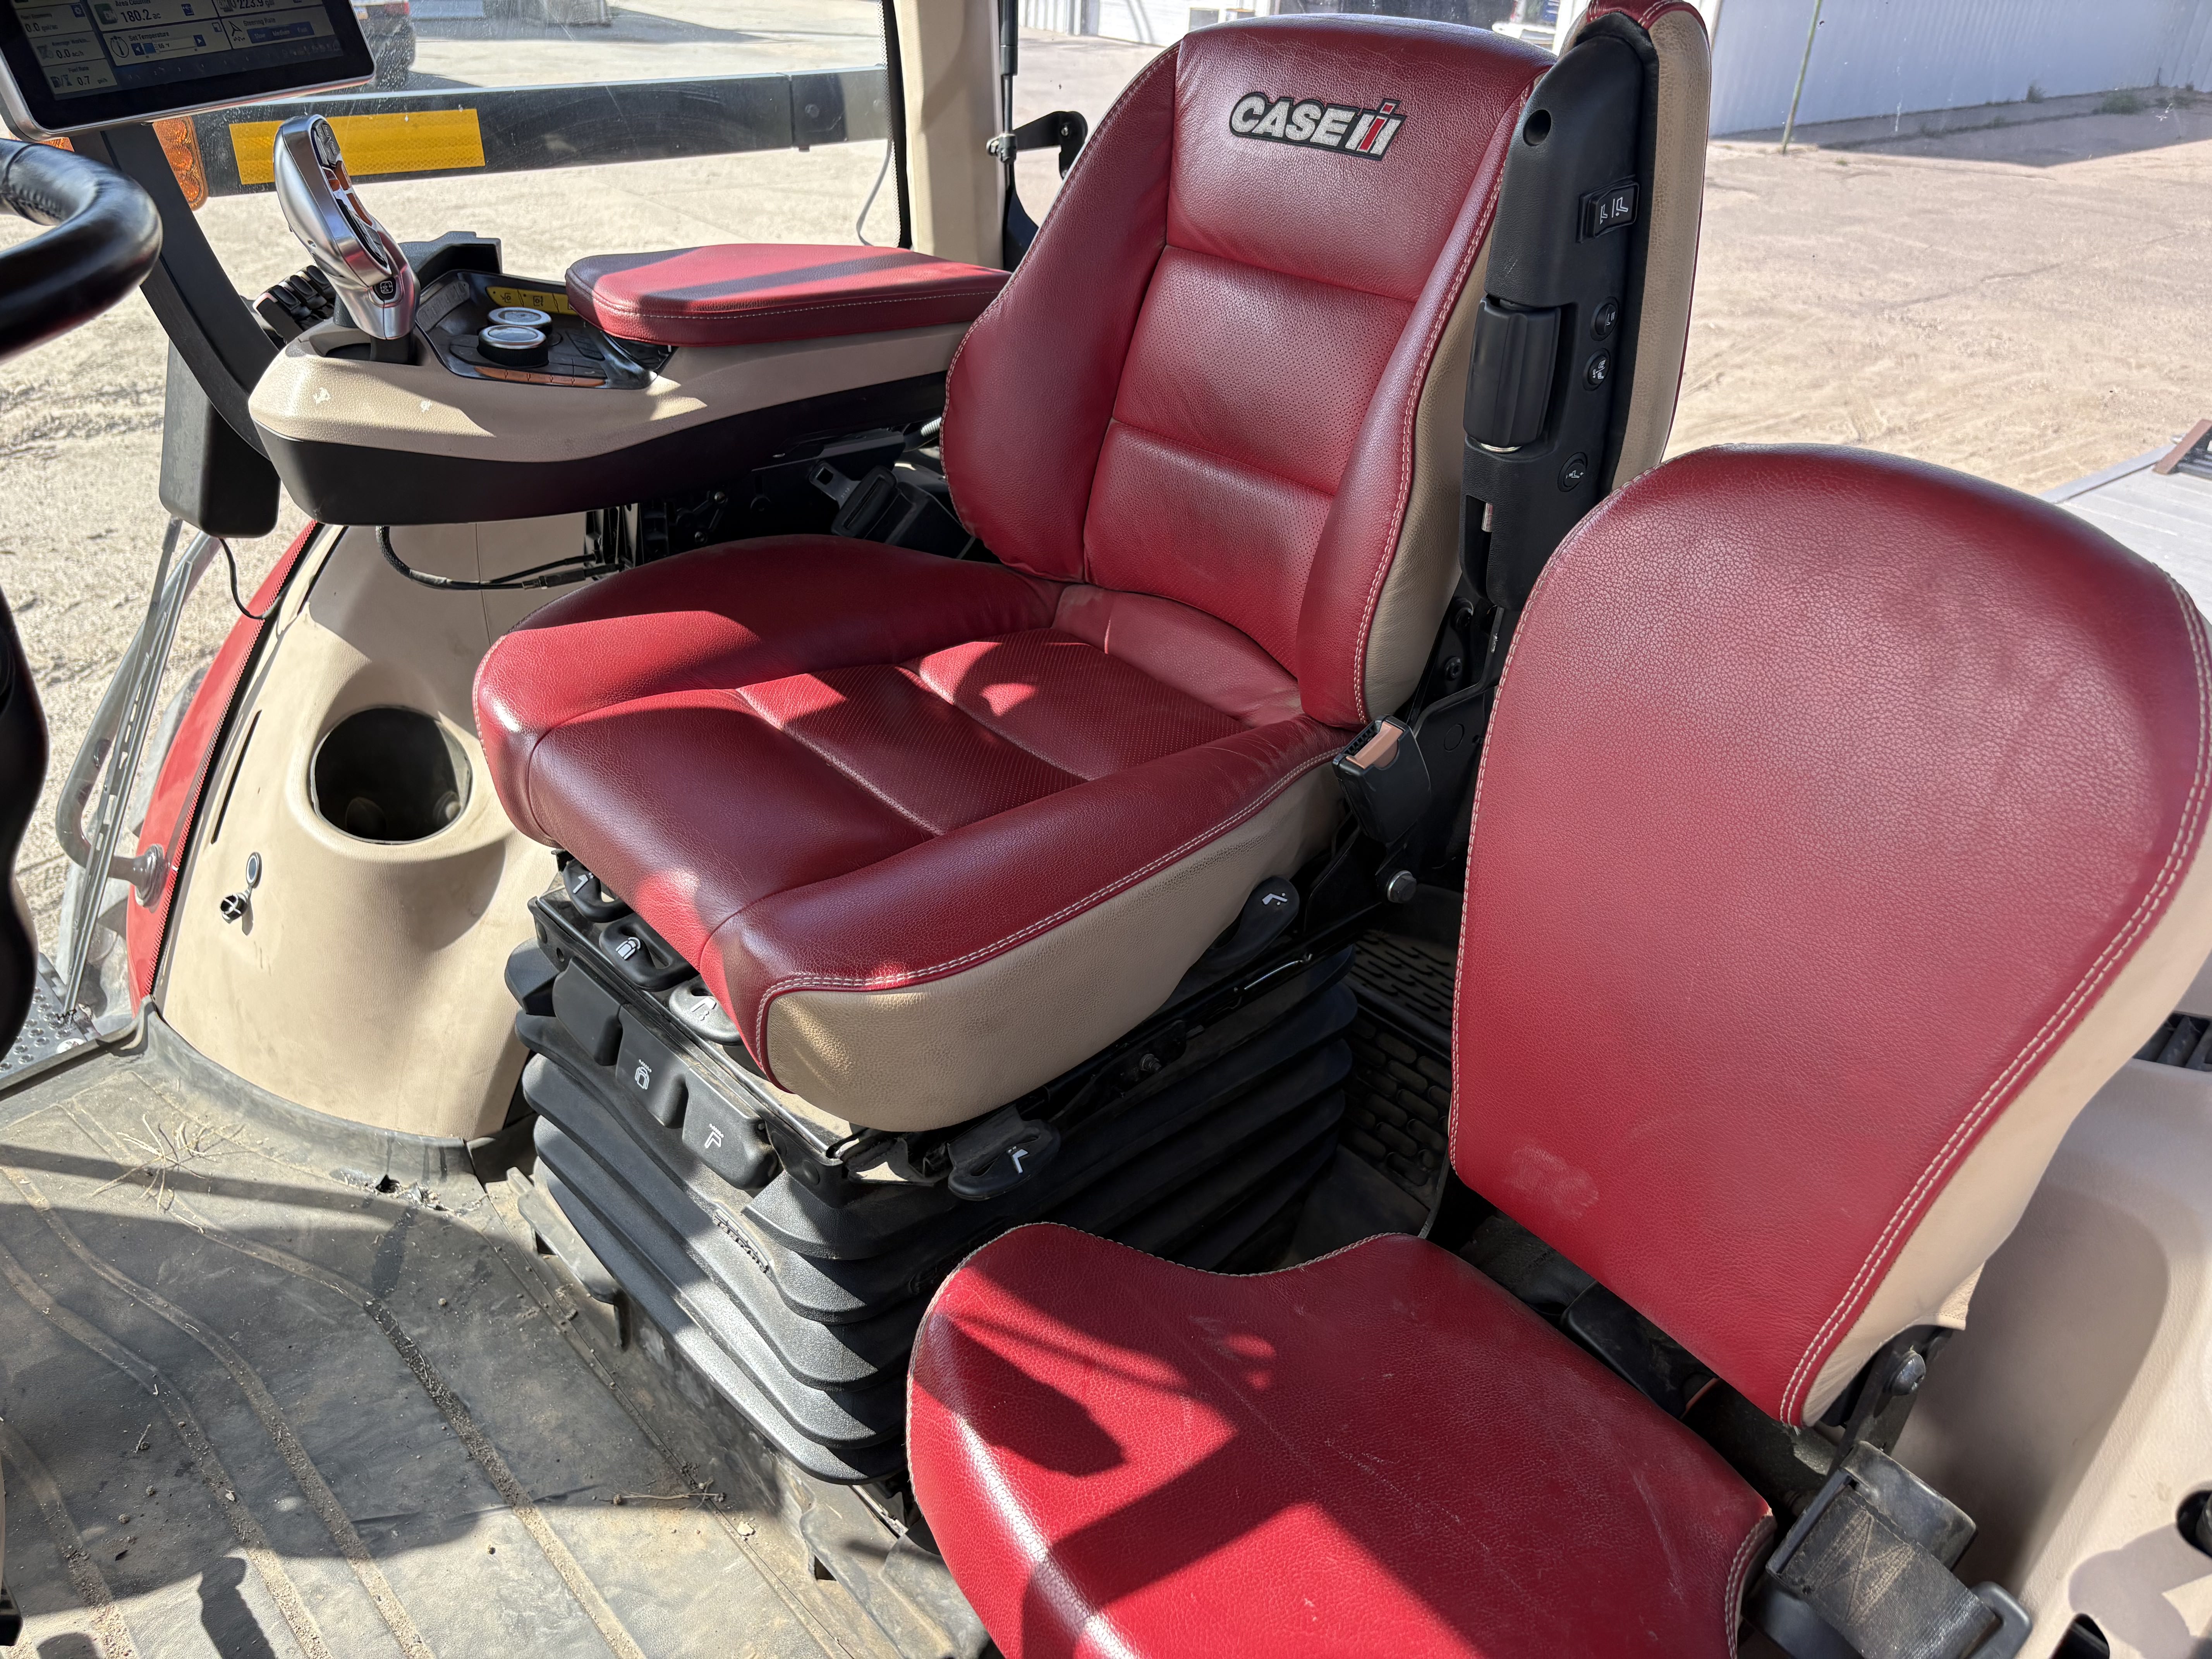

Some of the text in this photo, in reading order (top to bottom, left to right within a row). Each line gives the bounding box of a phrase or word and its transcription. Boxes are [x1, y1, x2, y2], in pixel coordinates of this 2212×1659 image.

[120, 9, 152, 22] 180.2
[25, 22, 40, 32] 0.0
[138, 31, 170, 40] Temperature
[56, 49, 71, 58] 0.0
[77, 76, 90, 86] 0.7
